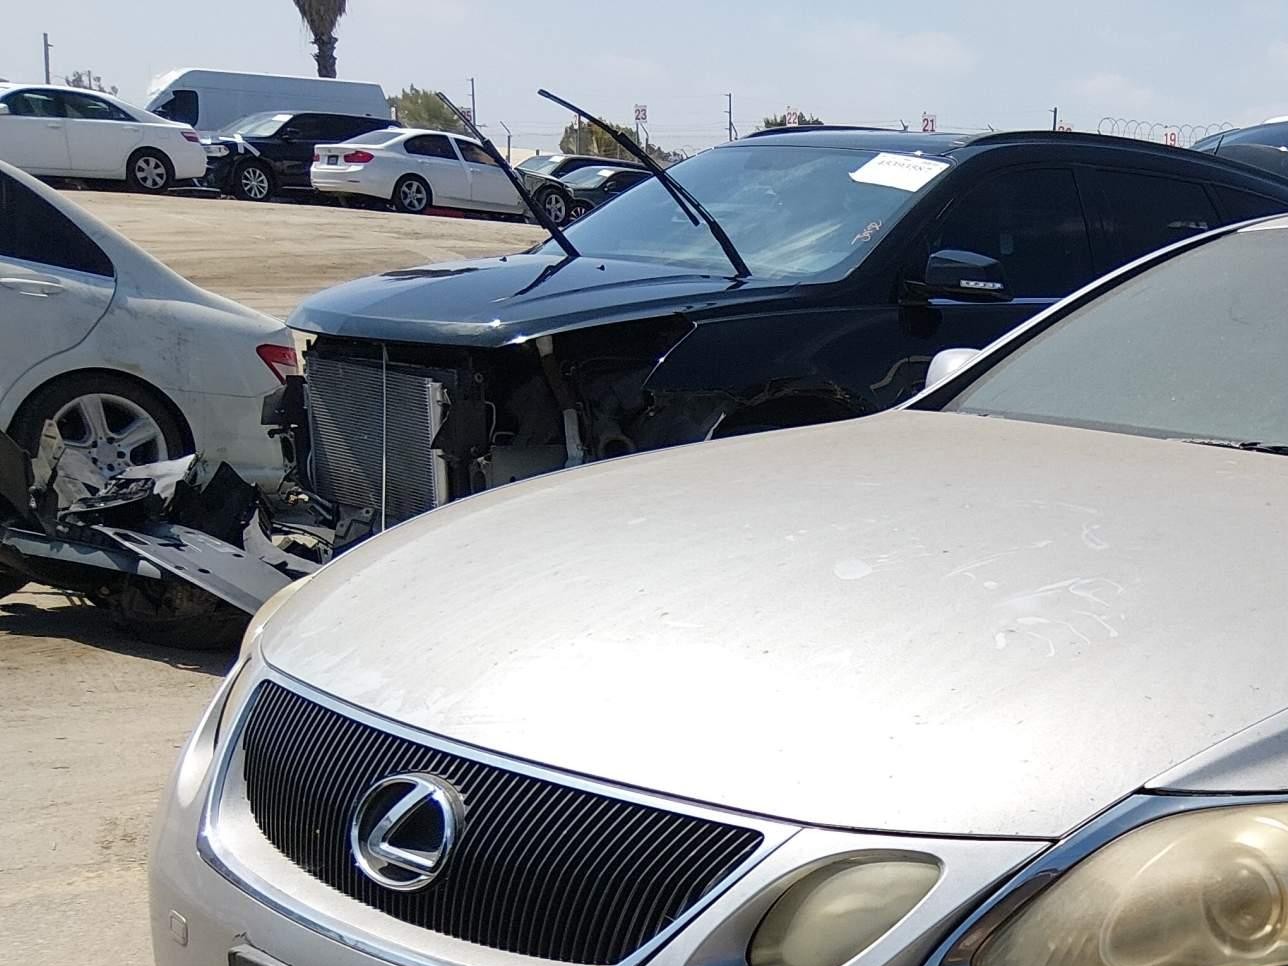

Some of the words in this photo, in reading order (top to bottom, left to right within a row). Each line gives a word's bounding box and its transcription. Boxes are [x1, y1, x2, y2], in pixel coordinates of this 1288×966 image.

[635, 108, 648, 121] 23
[787, 111, 798, 125] 22
[922, 118, 936, 133] 21
[1164, 132, 1177, 146] 19
